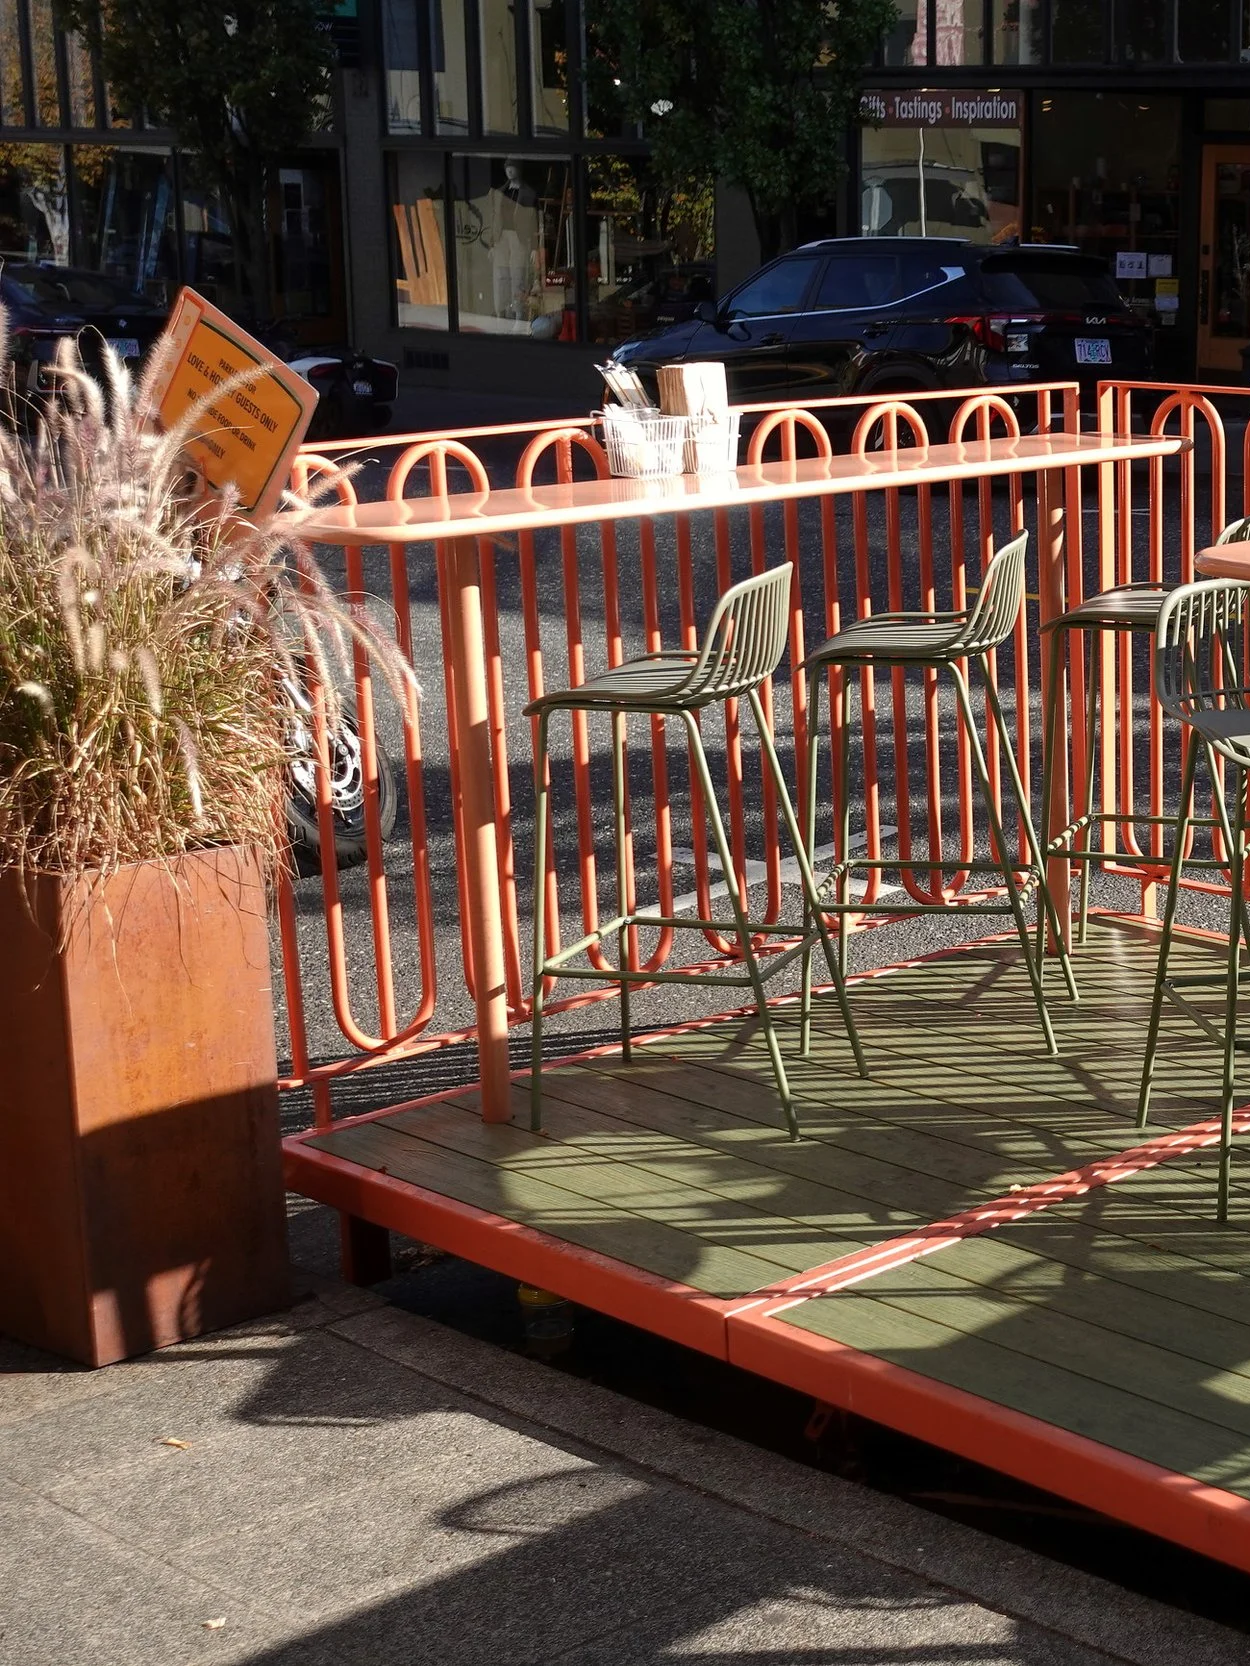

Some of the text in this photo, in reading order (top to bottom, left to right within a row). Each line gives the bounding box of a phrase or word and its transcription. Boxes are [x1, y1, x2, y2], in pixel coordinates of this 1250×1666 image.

[894, 95, 942, 124] Tastings
[951, 95, 1017, 124] Inspiration
[187, 351, 205, 372] LOVE
[203, 365, 210, 377] &
[235, 392, 261, 420] GUESTS
[259, 412, 279, 434] ONLY
[187, 387, 197, 400] NO
